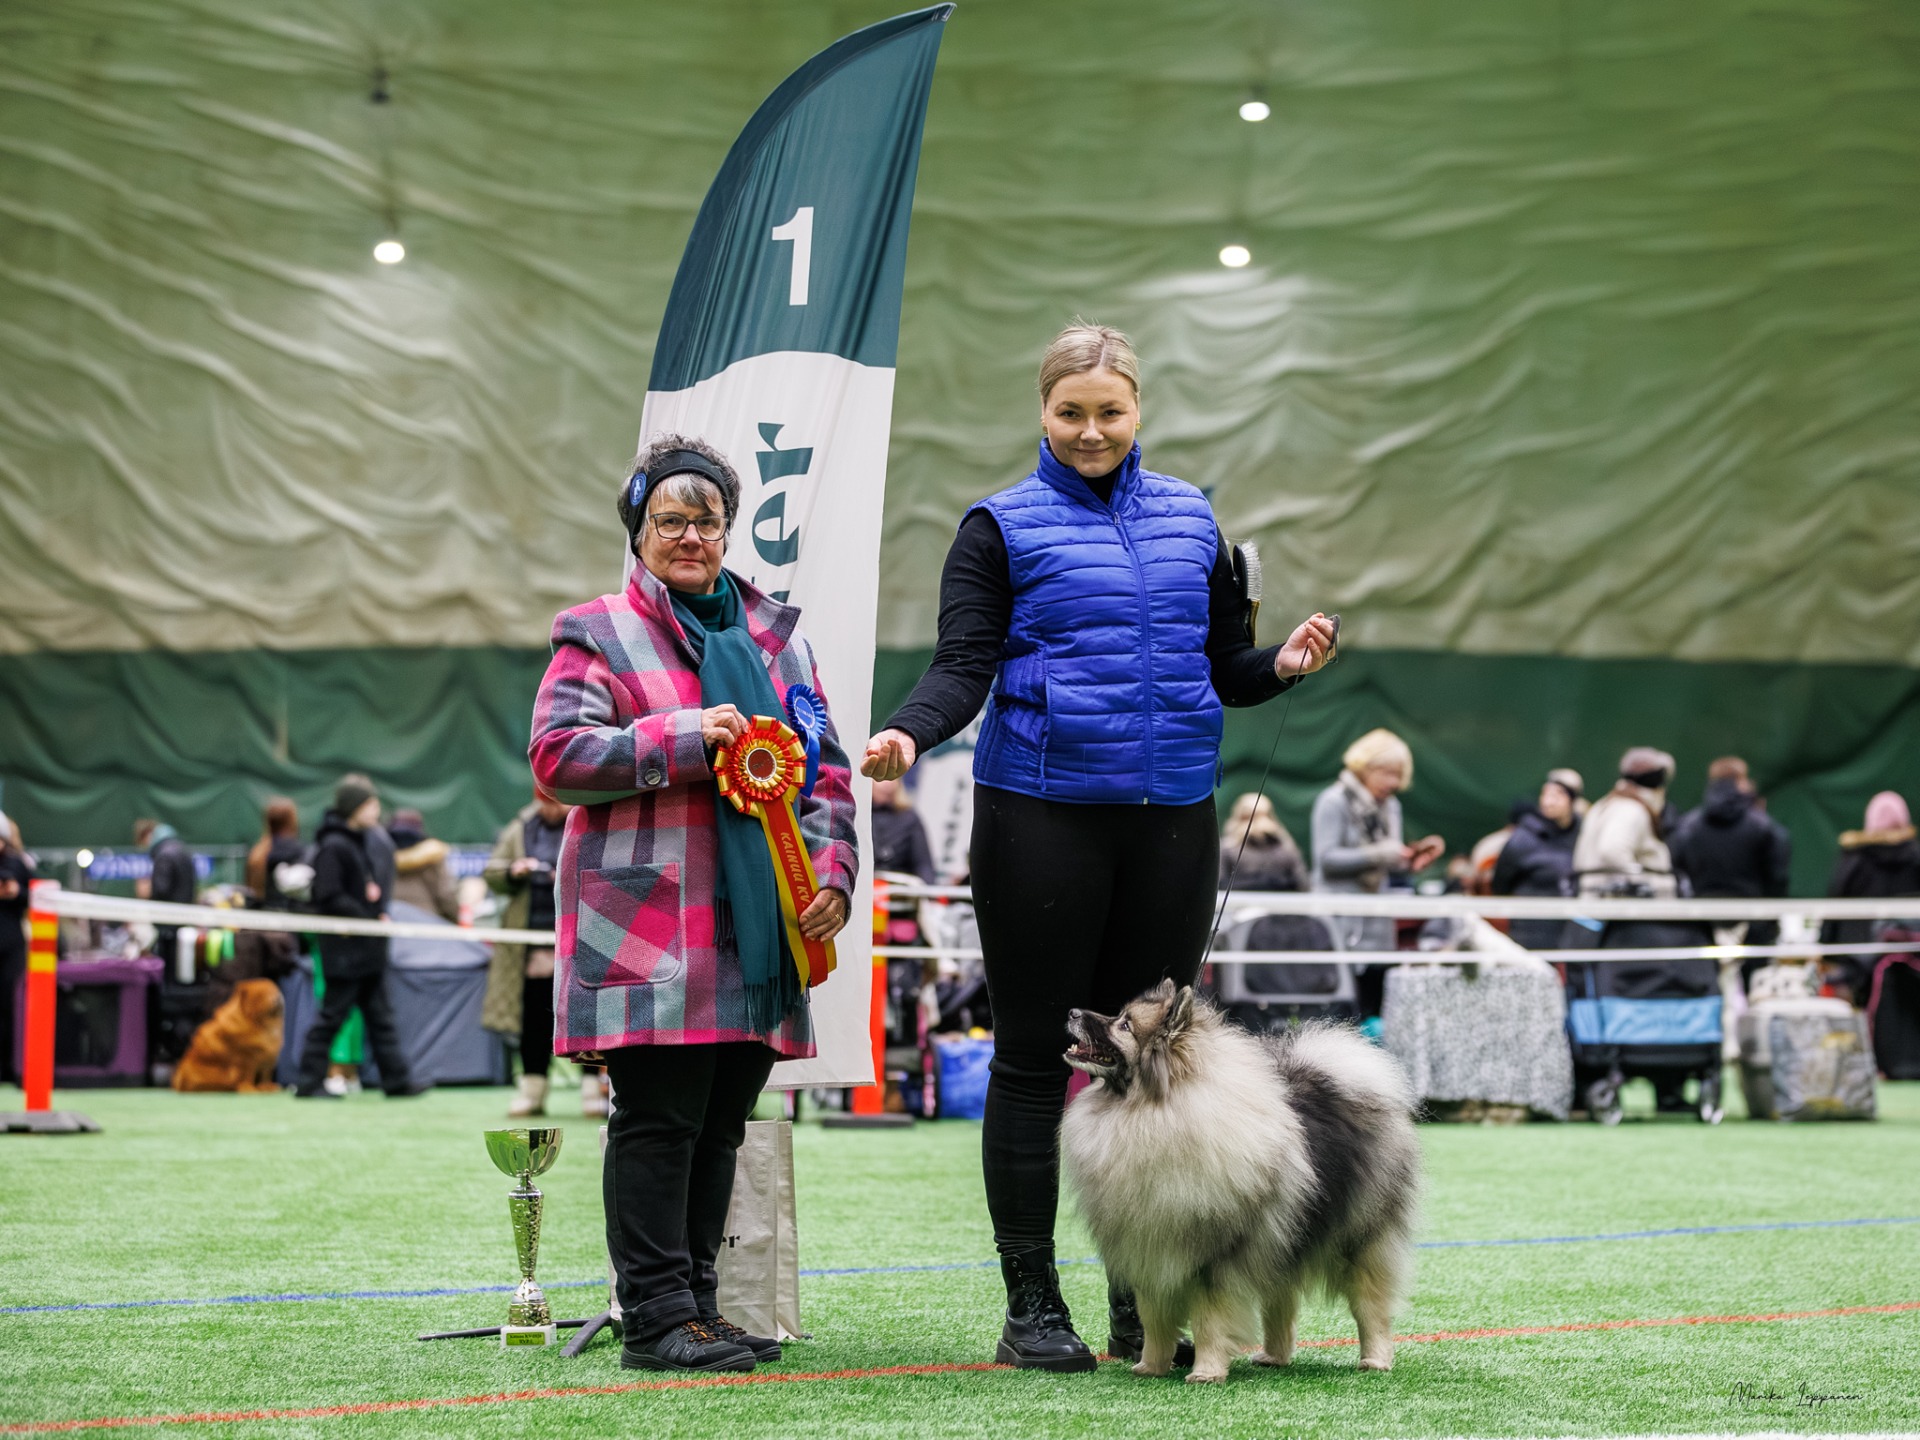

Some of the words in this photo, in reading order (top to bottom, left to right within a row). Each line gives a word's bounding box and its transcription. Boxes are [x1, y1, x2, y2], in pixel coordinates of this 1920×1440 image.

[772, 206, 814, 305] 1
[752, 422, 814, 604] er
[781, 832, 804, 882] KAINUU
[722, 1235, 741, 1248] r
